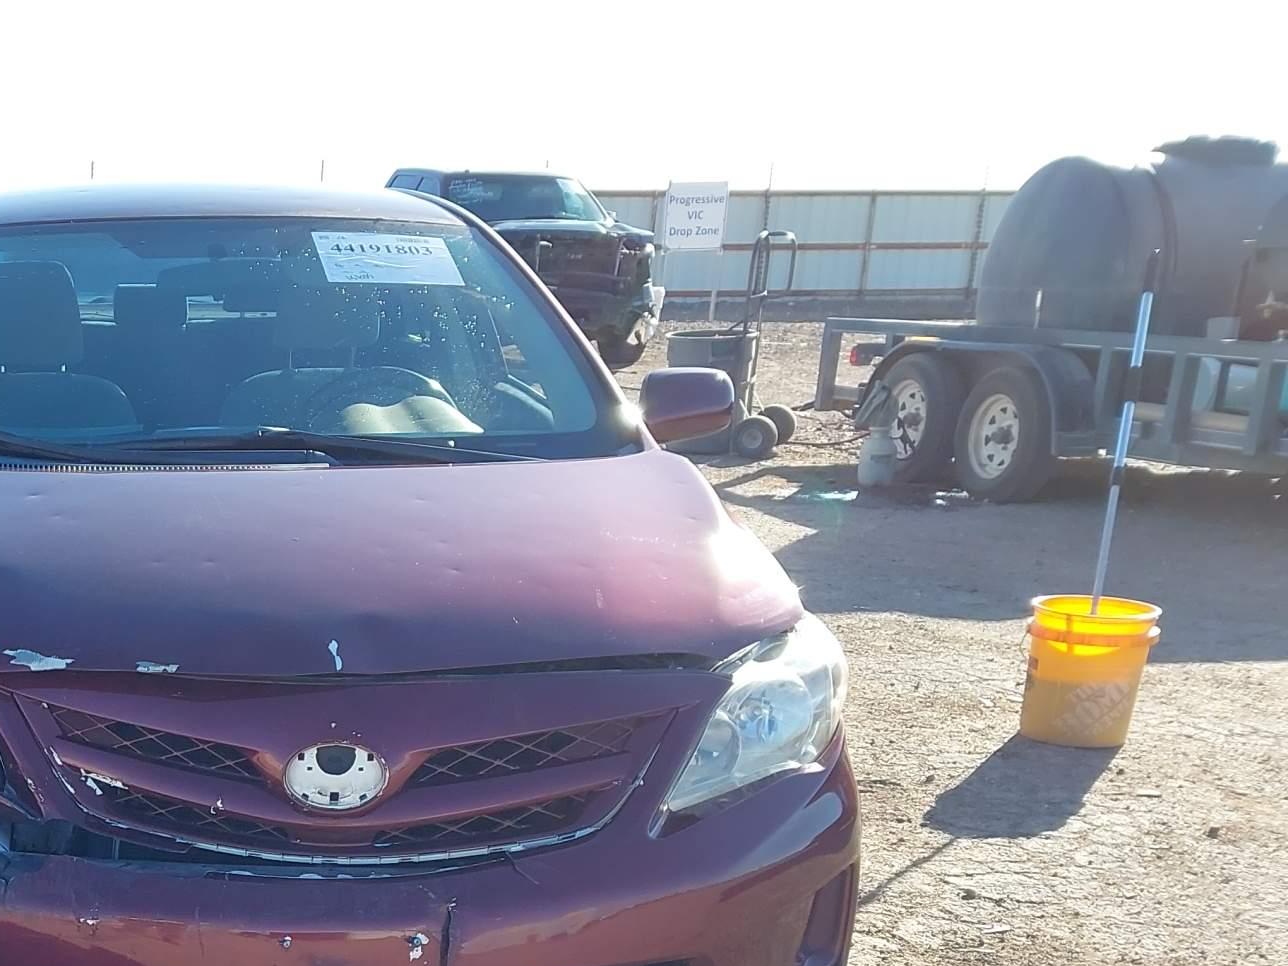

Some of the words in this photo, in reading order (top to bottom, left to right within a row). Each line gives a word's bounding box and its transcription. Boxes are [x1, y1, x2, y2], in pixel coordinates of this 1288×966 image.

[669, 194, 725, 207] Progressive
[687, 210, 704, 220] VIC
[669, 226, 692, 237] Drop
[695, 226, 719, 236] Zone
[330, 243, 433, 256] 44191803
